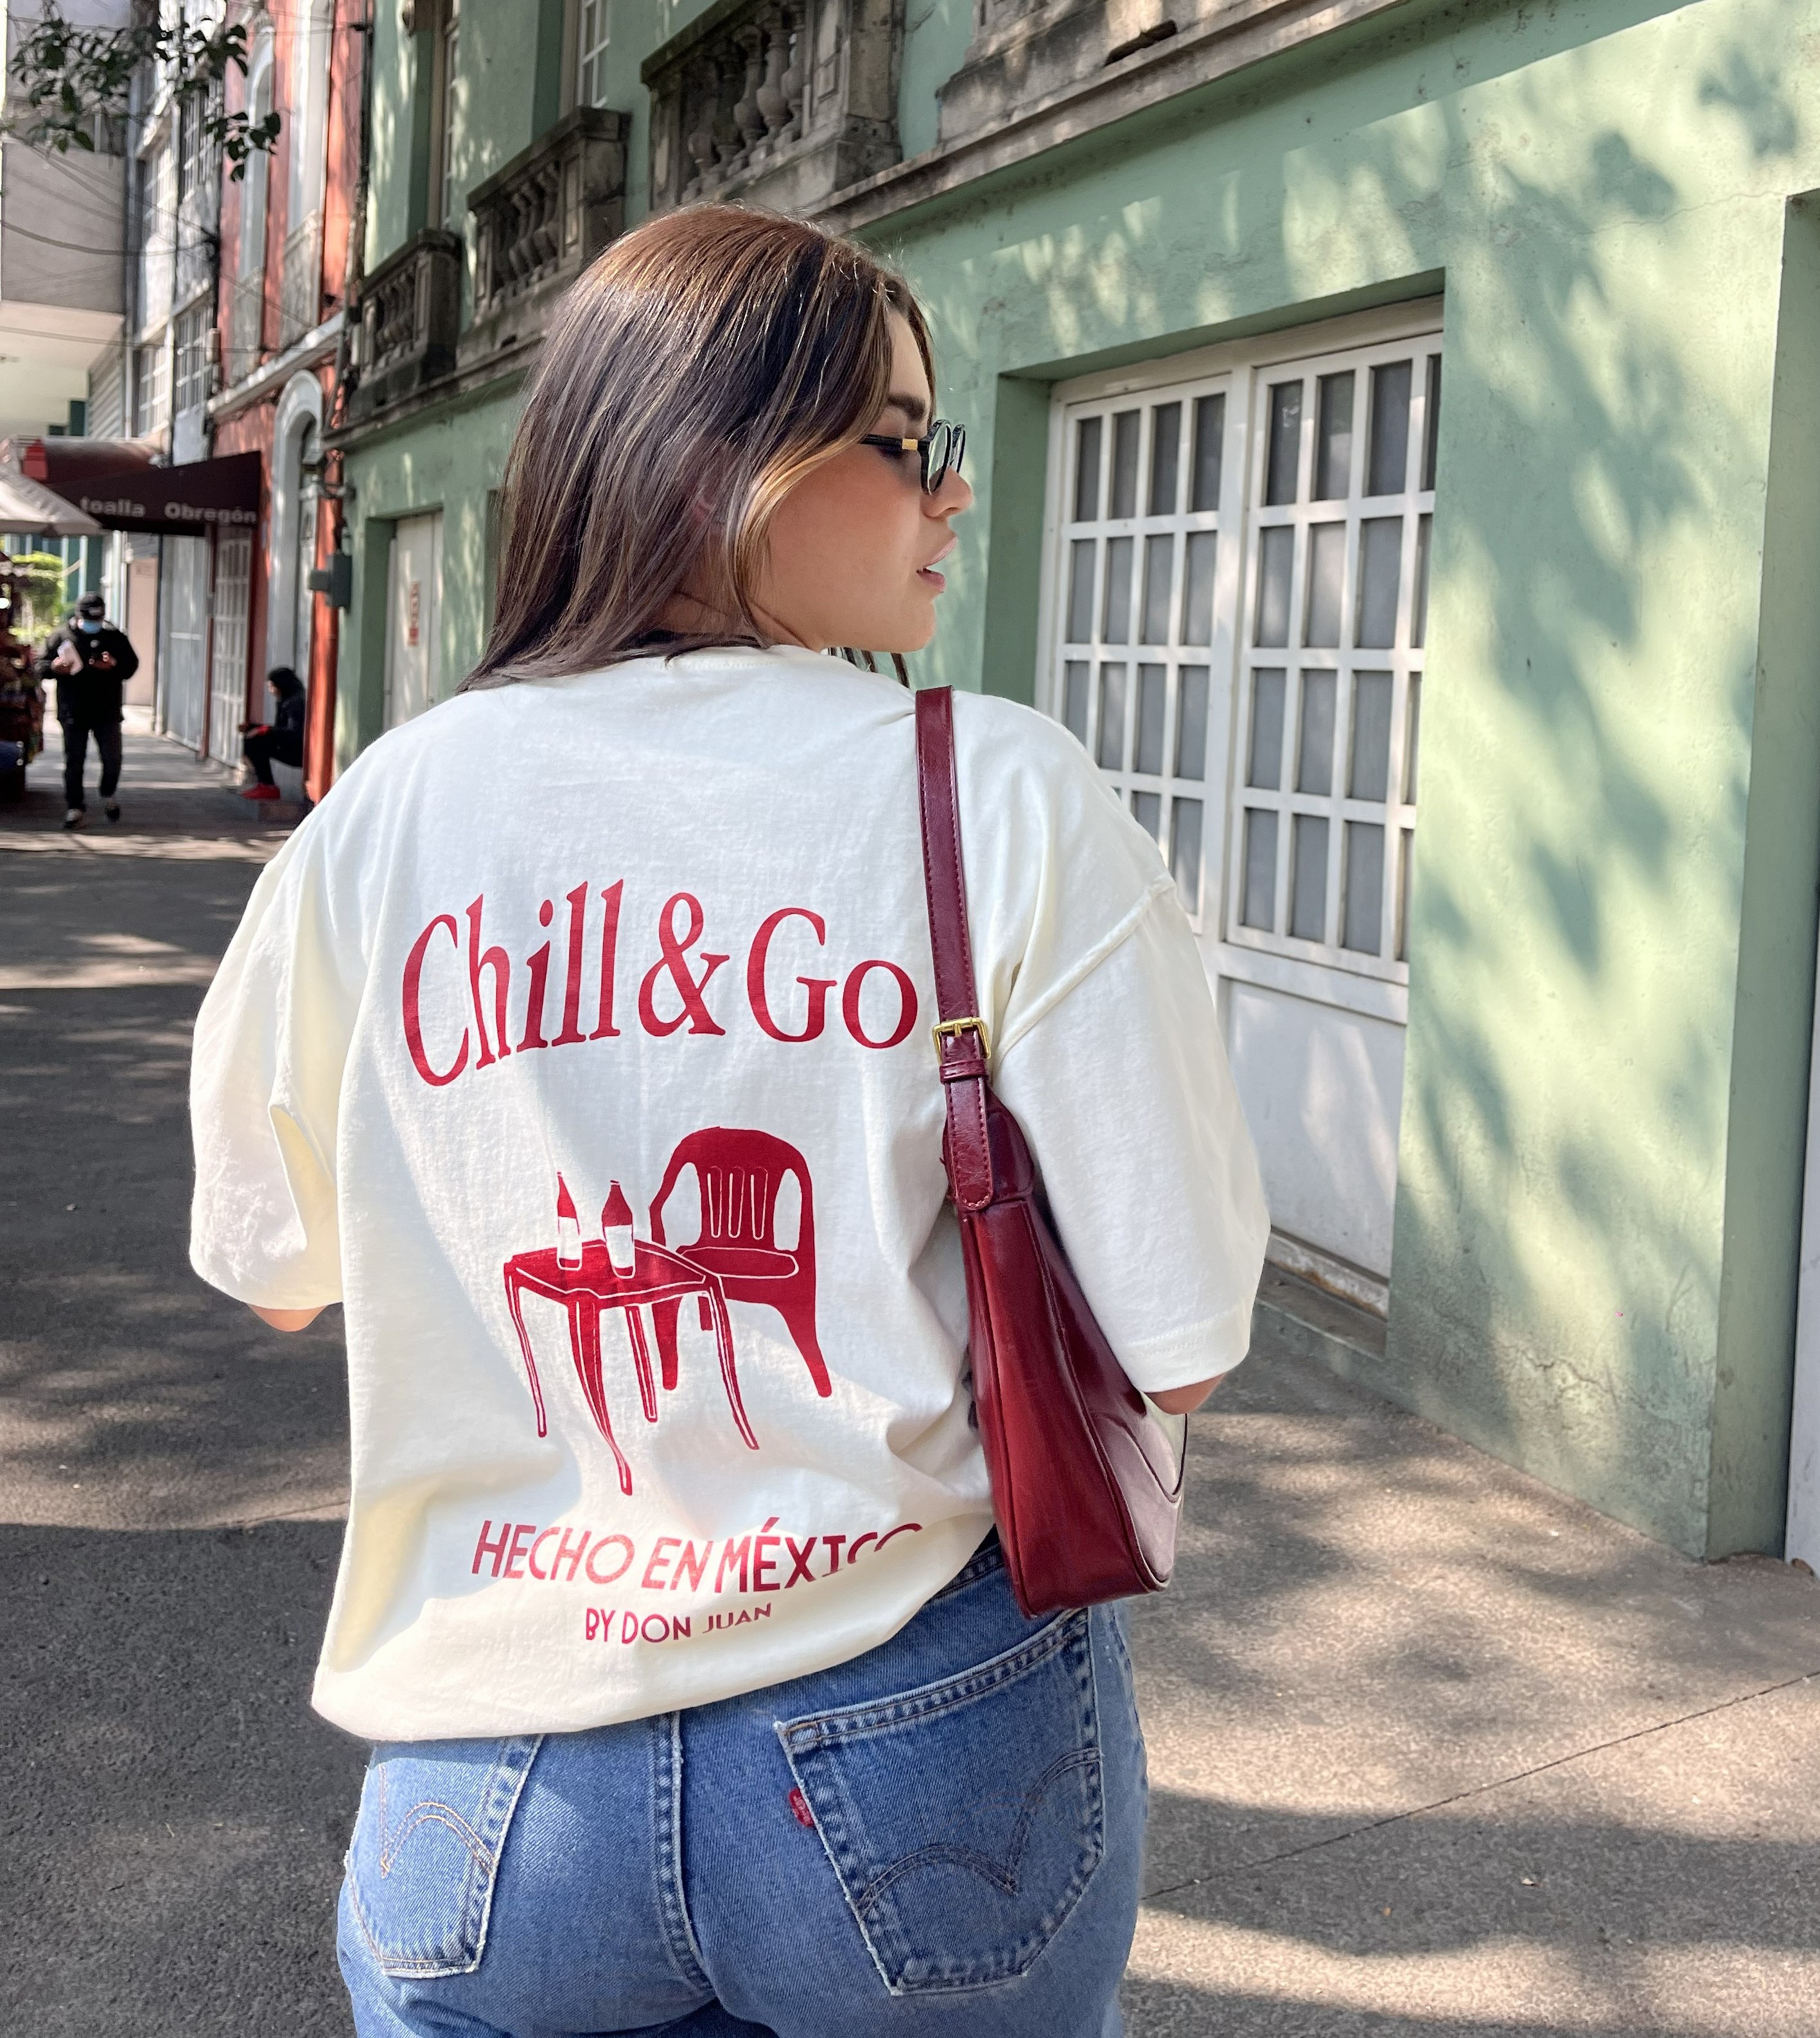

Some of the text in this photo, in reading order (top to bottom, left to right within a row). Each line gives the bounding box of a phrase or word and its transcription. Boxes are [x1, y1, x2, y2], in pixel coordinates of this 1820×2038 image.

[402, 878, 918, 1087] Chill & Go
[471, 1520, 635, 1585] HECHO
[641, 1537, 712, 1592] EN
[585, 1603, 772, 1644] BY DON JUAN
